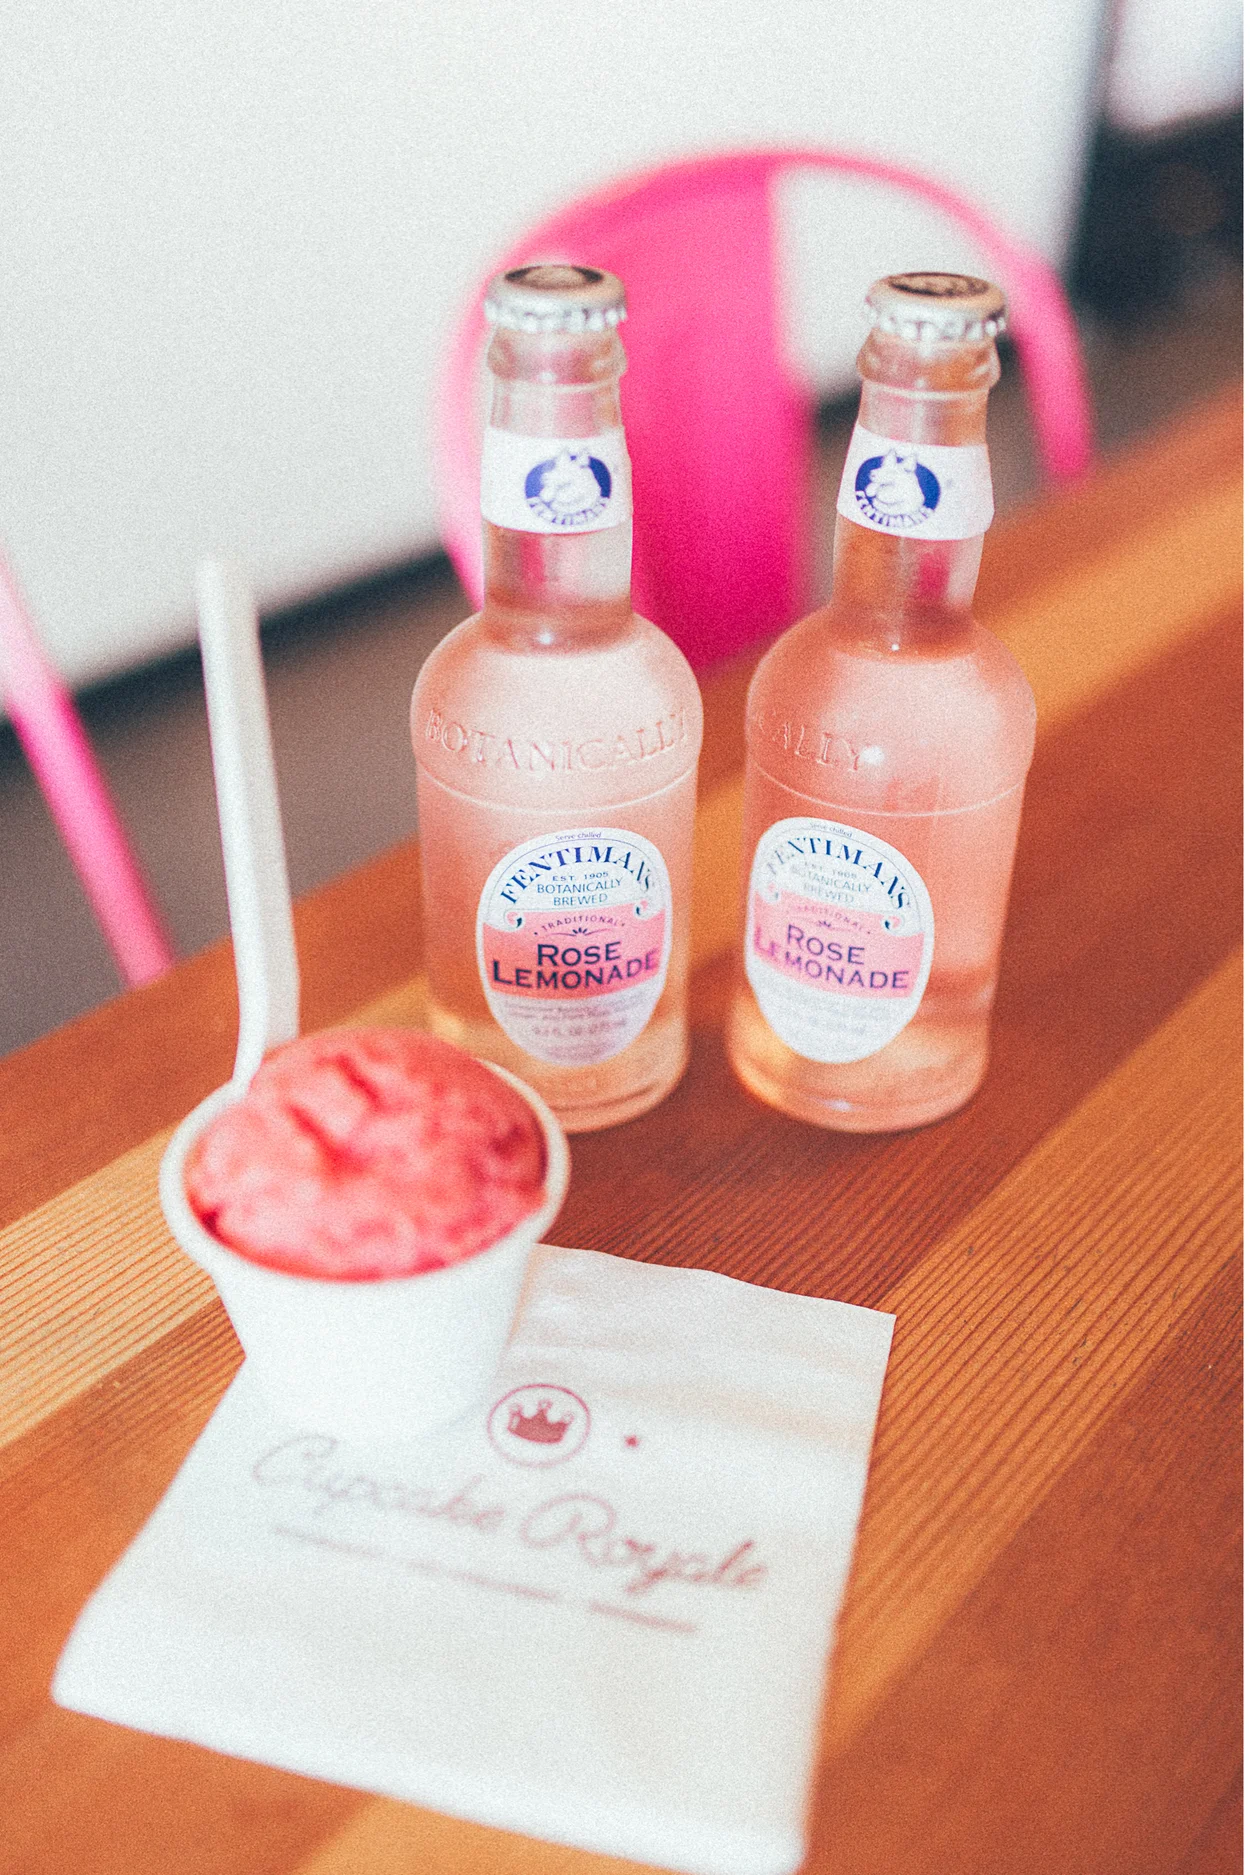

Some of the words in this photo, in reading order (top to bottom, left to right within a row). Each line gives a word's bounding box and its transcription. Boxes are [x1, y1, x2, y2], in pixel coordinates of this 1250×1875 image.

[500, 846, 656, 904] FENTIMANS
[537, 877, 623, 894] BOTANICALLY
[766, 837, 912, 909] FENTIMANS
[553, 893, 609, 906] BREWED
[541, 915, 620, 931] TRADITIONAL
[537, 941, 622, 967] ROSE
[787, 924, 865, 965] ROSE
[492, 948, 659, 990] LEMONADE
[519, 1491, 770, 1596] Royale
